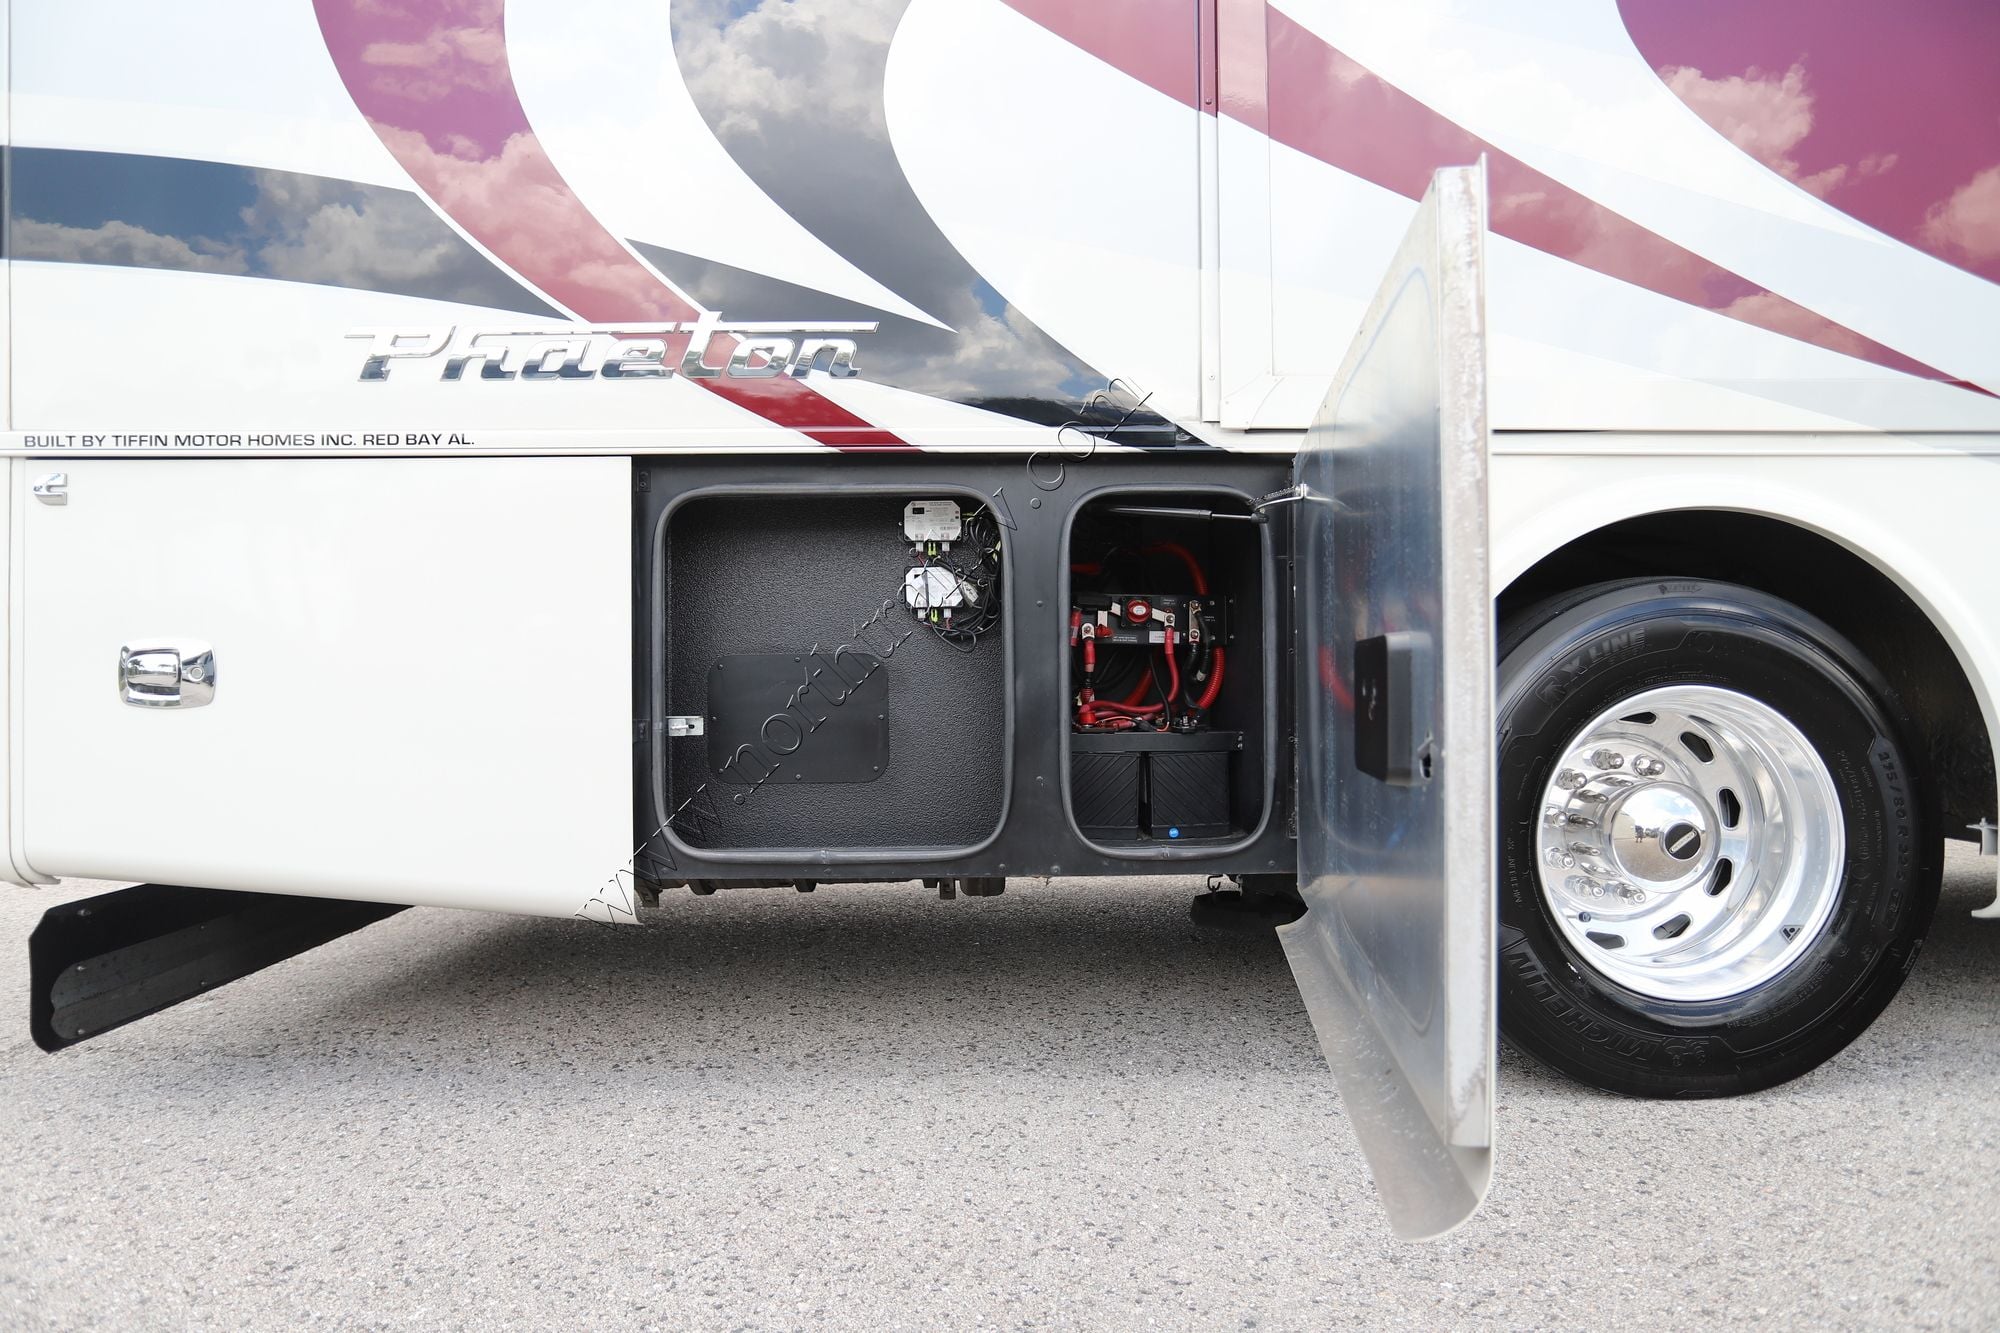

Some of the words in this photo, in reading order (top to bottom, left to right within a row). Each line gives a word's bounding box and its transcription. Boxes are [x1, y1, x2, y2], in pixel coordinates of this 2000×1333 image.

[344, 310, 880, 382] Phaeton
[24, 435, 76, 448] BUILT
[81, 435, 107, 447] BY
[111, 434, 168, 447] TIFFIN
[174, 434, 242, 447] MOTOR
[247, 434, 316, 446] HOMES
[320, 434, 357, 446] INC.
[362, 433, 400, 446] RED
[405, 433, 442, 446] BAY
[447, 433, 476, 445] AL.
[1588, 627, 1646, 661] LINE
[1506, 951, 1658, 1062] MICHELIN
